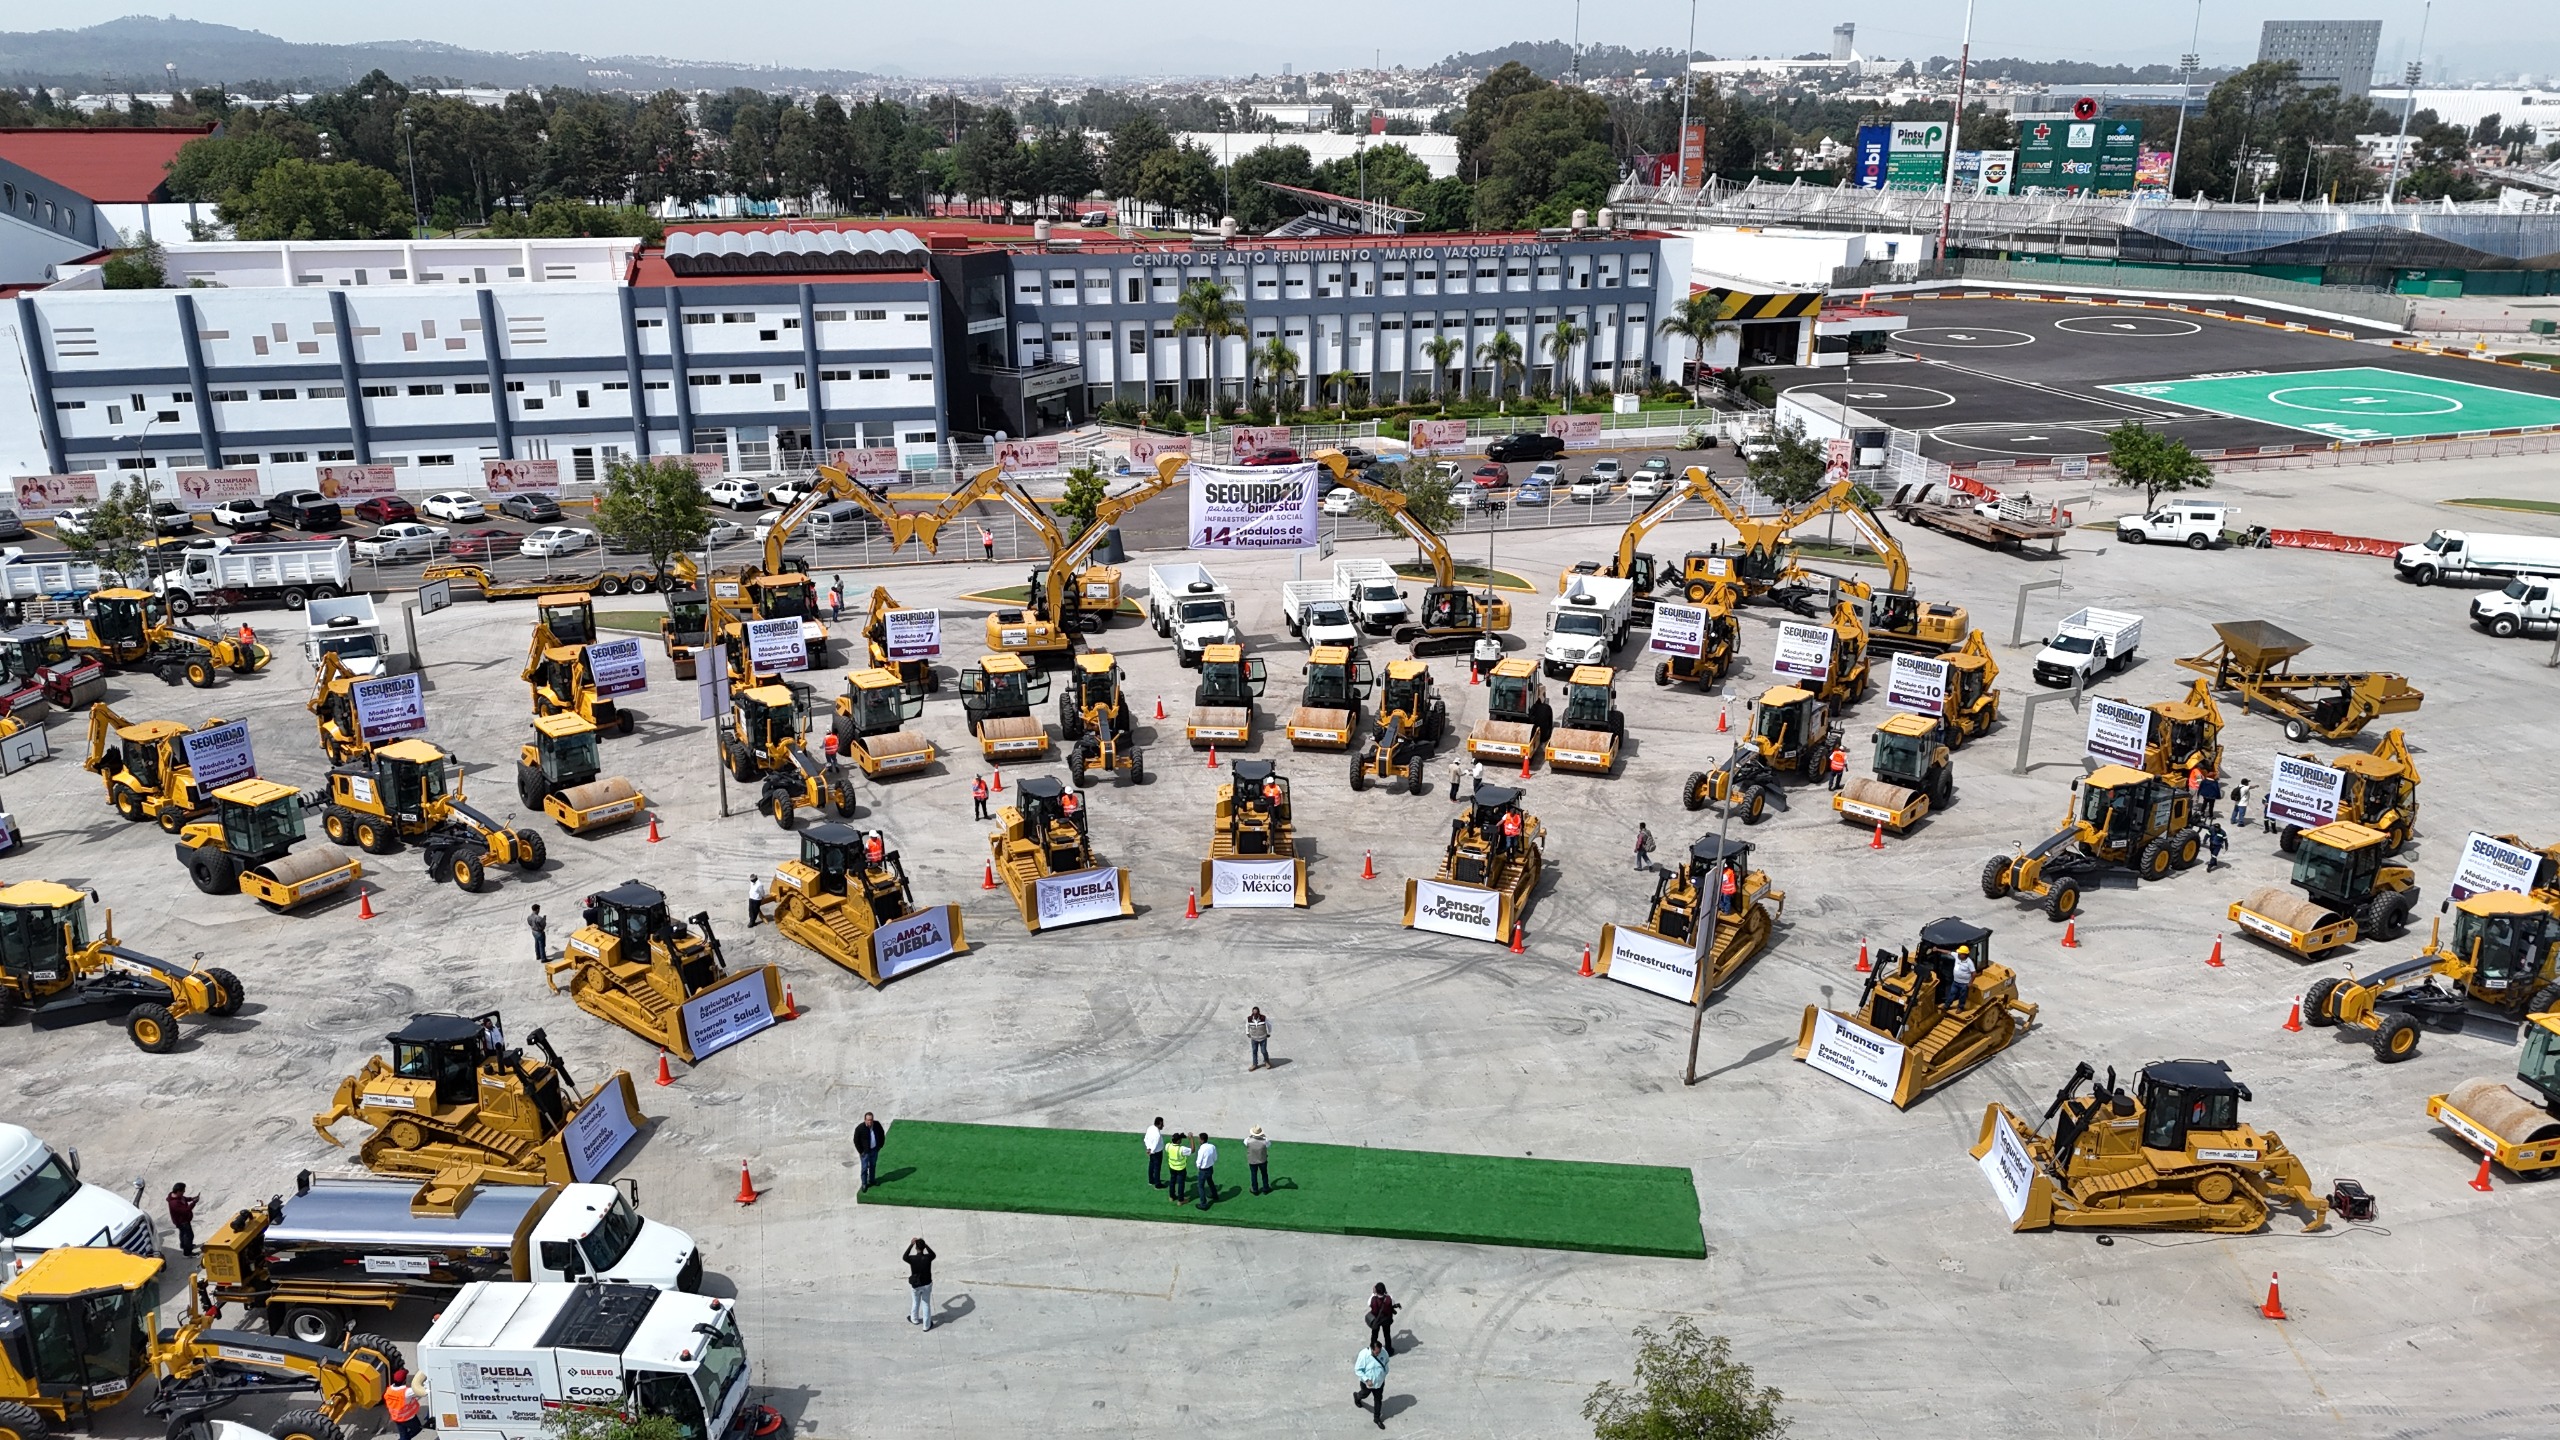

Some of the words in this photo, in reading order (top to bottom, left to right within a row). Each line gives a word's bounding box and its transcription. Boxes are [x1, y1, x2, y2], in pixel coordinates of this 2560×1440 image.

[1898, 129, 1924, 139] Pintu
[1862, 143, 1881, 190] Mobil
[1132, 253, 1192, 266] CENTRO
[1200, 252, 1217, 265] DE
[1226, 251, 1266, 264] ALTO
[1274, 248, 1370, 262] RENDIMIENTO
[1442, 245, 1505, 258] VAZQUEZ
[1206, 505, 1234, 514] para
[1236, 503, 1246, 513] el
[1248, 502, 1302, 514] bienestar
[1204, 526, 1232, 546] 14
[1236, 526, 1286, 536] Módulos
[1288, 526, 1303, 535] de
[1236, 536, 1302, 548] Maquinaria
[926, 632, 934, 642] 7
[1688, 632, 1697, 642] 8
[790, 642, 800, 654] 6
[1665, 642, 1686, 650] Puebla
[1814, 653, 1823, 664] 9
[630, 665, 640, 676] 5
[611, 682, 630, 692] Libres
[1926, 686, 1941, 698] 10
[1899, 696, 1932, 708] Tochimilco
[406, 704, 417, 715] 4
[368, 712, 406, 722] Maquinaria
[378, 722, 412, 733] Teziutlán
[2130, 736, 2142, 750] 11
[238, 753, 248, 766] 3
[200, 762, 238, 778] Maquinaria
[205, 770, 249, 790] Zacapoaxtla
[2302, 777, 2334, 790] bienestar
[2276, 794, 2314, 808] Maquinaria
[2278, 788, 2304, 800] Módulo
[2316, 798, 2334, 814] 12
[2286, 808, 2316, 822] Acatlán
[2492, 860, 2528, 877] bienestar
[1064, 881, 1114, 898] PUEBLA
[1242, 880, 1292, 892] México
[2491, 880, 2502, 888] de
[1064, 896, 1088, 904] Gobierno
[1436, 894, 1486, 914] Pensar
[1422, 904, 1439, 916] en
[1438, 907, 1491, 926] Grande
[882, 938, 897, 948] POR
[896, 922, 932, 943] AMOR
[883, 930, 943, 962] PUEBLA
[1616, 946, 1693, 978] Infraestructura
[700, 992, 736, 1013] Agricultura
[700, 1001, 732, 1020] Desarrollo
[734, 992, 750, 1004] Rural
[734, 1004, 760, 1022] Salud
[694, 1018, 727, 1037] Desarrollo
[696, 1028, 724, 1044] Turístico
[1836, 1024, 1884, 1055] Finanzas
[1820, 1044, 1855, 1064] Desarrollo
[1818, 1050, 1854, 1072] Económico
[1862, 1070, 1888, 1088] Trabajo
[584, 1127, 608, 1154] Desarrollo
[586, 1129, 614, 1162] Sustentable
[480, 1367, 532, 1376] PUEBLA
[94, 1385, 126, 1394] PUEBLA
[569, 1387, 616, 1396] 6000
[460, 1394, 539, 1402] Infraestructura
